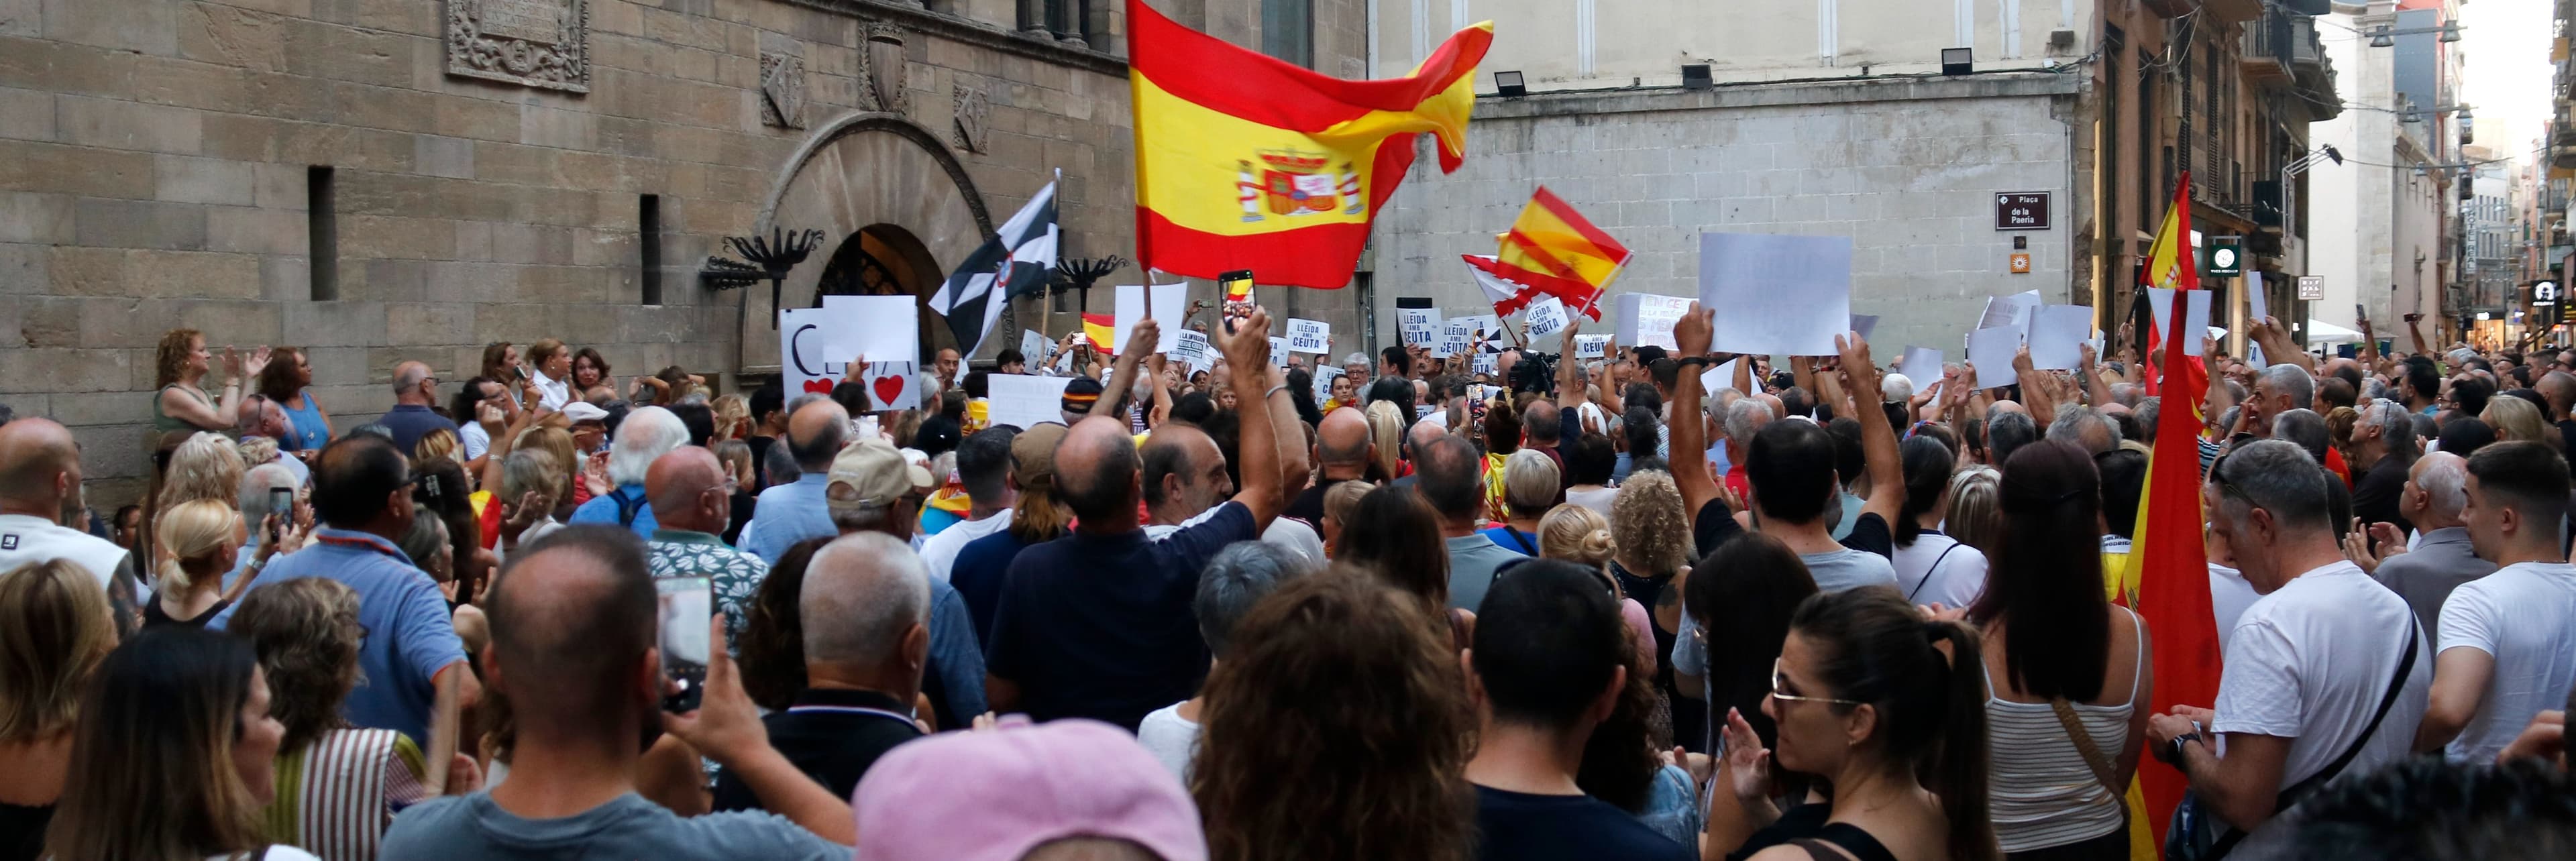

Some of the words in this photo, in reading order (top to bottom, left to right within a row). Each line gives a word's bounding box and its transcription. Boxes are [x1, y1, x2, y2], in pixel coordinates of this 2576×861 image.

[1529, 306, 1551, 321] LLEIDA
[1404, 315, 1427, 324] LLEIDA
[1297, 324, 1319, 333] LLEIDA
[1444, 327, 1467, 335] LLEIDA
[1532, 318, 1560, 335] CEUTA
[1293, 337, 1319, 349] CEUTA
[1584, 342, 1605, 353] CEUT
